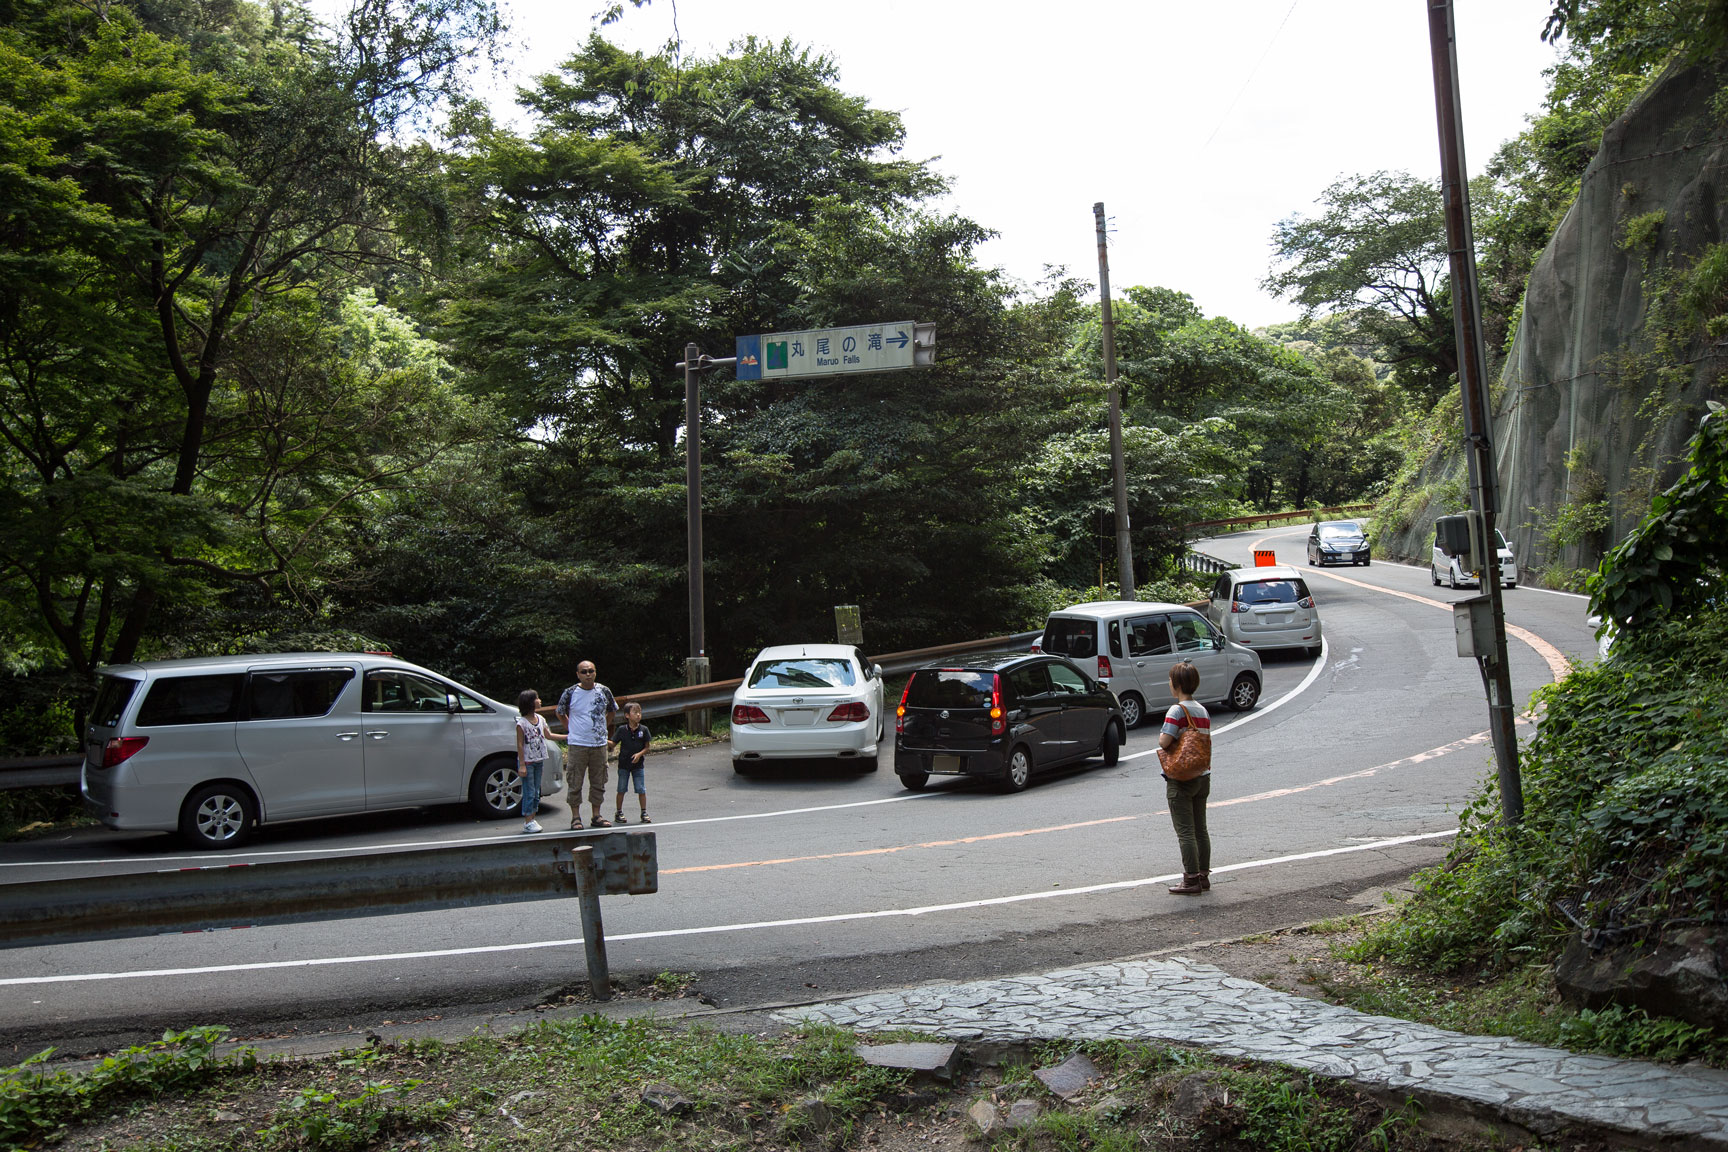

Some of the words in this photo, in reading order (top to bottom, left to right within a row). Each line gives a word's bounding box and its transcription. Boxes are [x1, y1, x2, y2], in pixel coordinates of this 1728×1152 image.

[791, 333, 882, 357] 丸尾の滝
[816, 357, 839, 367] Maruo
[843, 355, 860, 364] Falls
